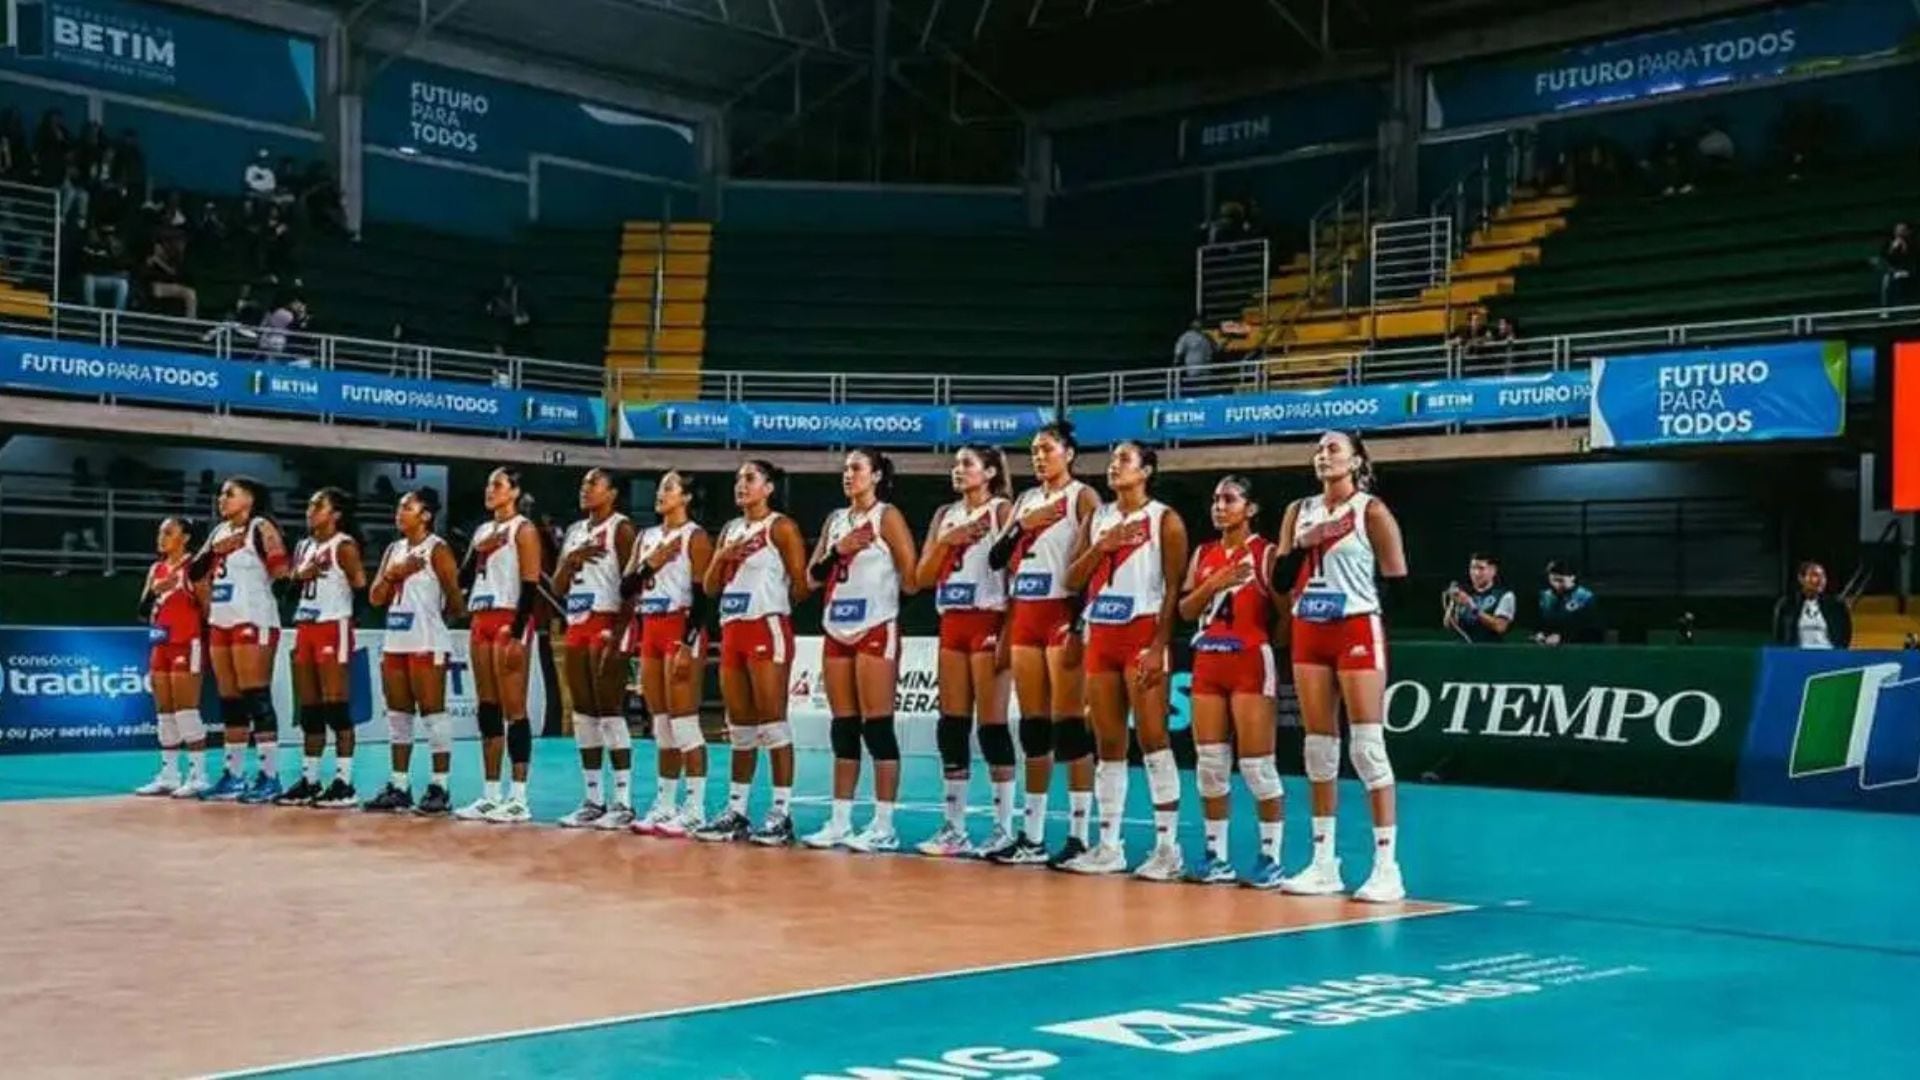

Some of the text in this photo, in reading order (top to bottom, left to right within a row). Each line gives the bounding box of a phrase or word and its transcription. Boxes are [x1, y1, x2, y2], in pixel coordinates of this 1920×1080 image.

[54, 16, 175, 67] BETIM
[1535, 29, 1795, 95] FUTURO PARA TODOS
[411, 82, 488, 114] FUTURO
[411, 101, 460, 128] PARA
[410, 121, 478, 152] TODOS
[21, 352, 219, 388] FUTURO PARA TODOS
[1659, 361, 1769, 388] FUTURO
[342, 384, 407, 406] FUTURO
[447, 394, 498, 414] TODOS
[1499, 385, 1570, 405] FUTURO
[1660, 389, 1725, 411] PARA
[753, 415, 822, 431] FUTURO
[862, 416, 922, 432] TODOS
[1225, 404, 1284, 423] FUTURO
[1322, 398, 1379, 417] TODOS
[1659, 410, 1753, 436] TODOS
[1383, 680, 1723, 747] O TEMPO
[30, 727, 55, 741] por
[1179, 974, 1435, 1014] MINAS
